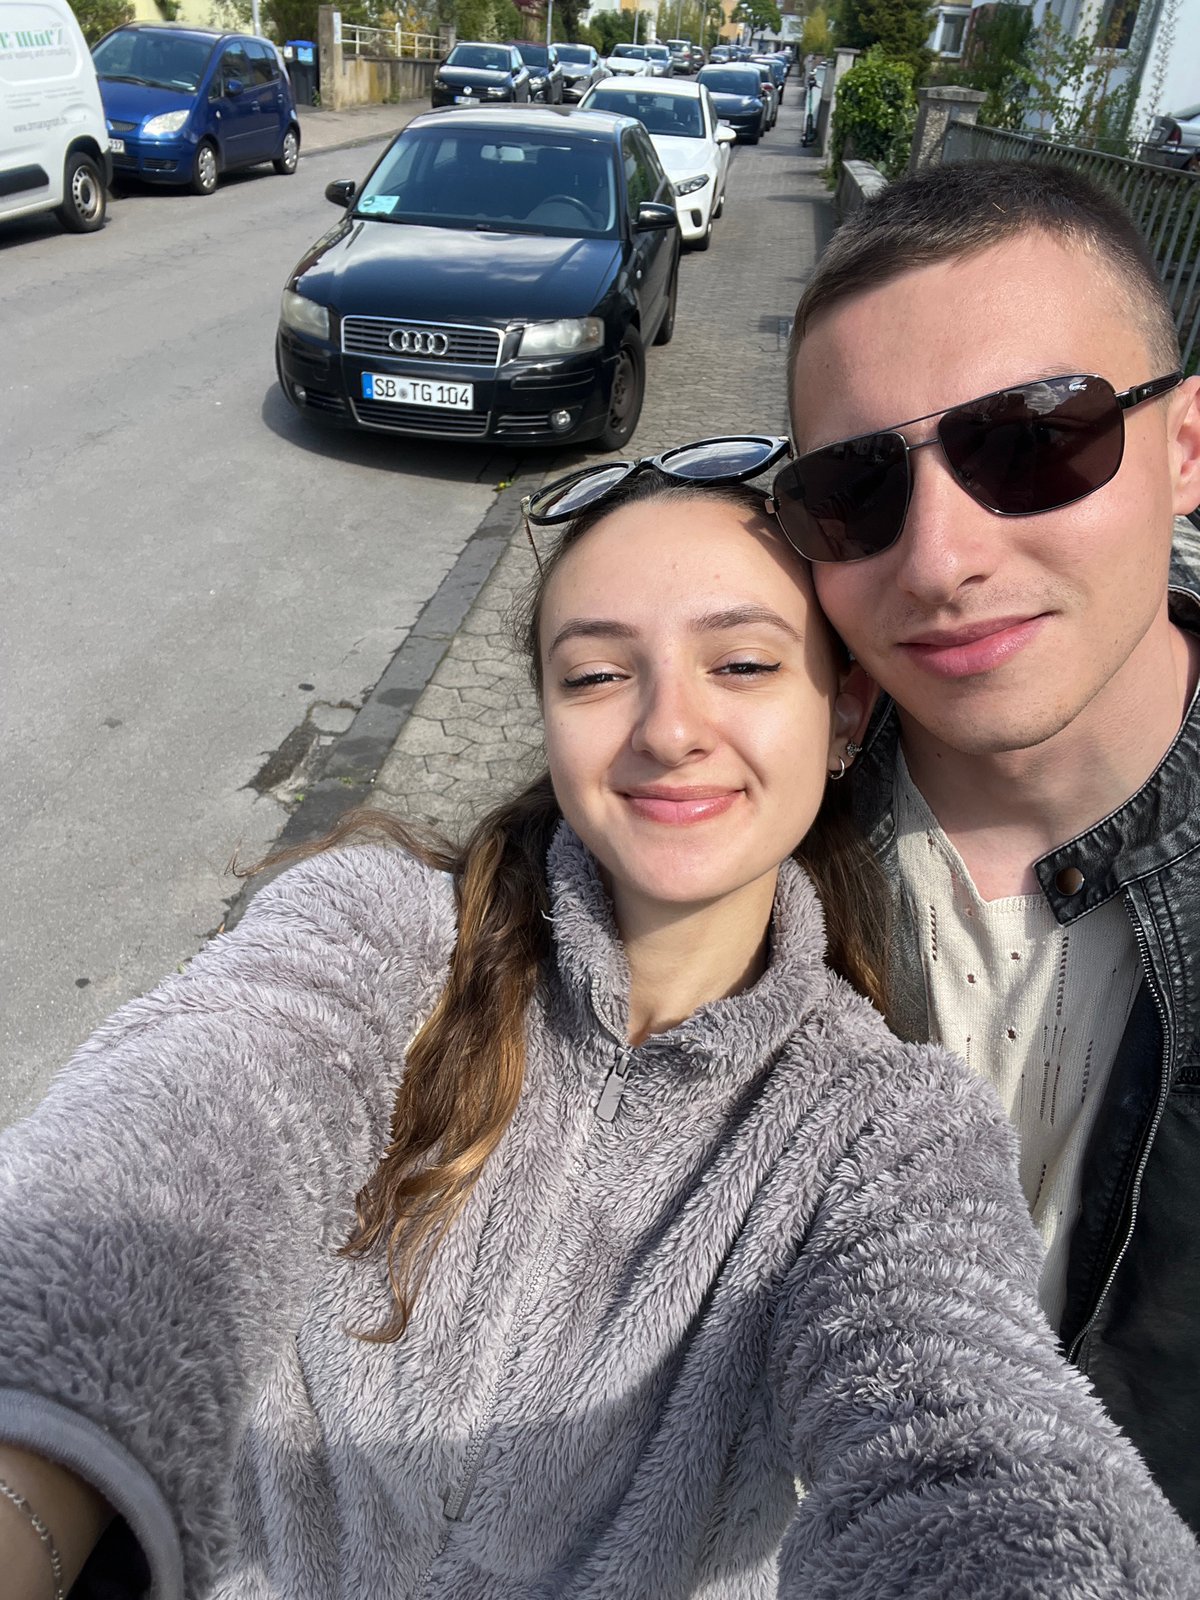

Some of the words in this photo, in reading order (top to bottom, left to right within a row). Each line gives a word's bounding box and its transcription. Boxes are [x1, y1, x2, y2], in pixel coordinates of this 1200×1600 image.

[375, 378, 396, 398] SB
[409, 382, 432, 402] TG
[437, 386, 469, 406] 104
